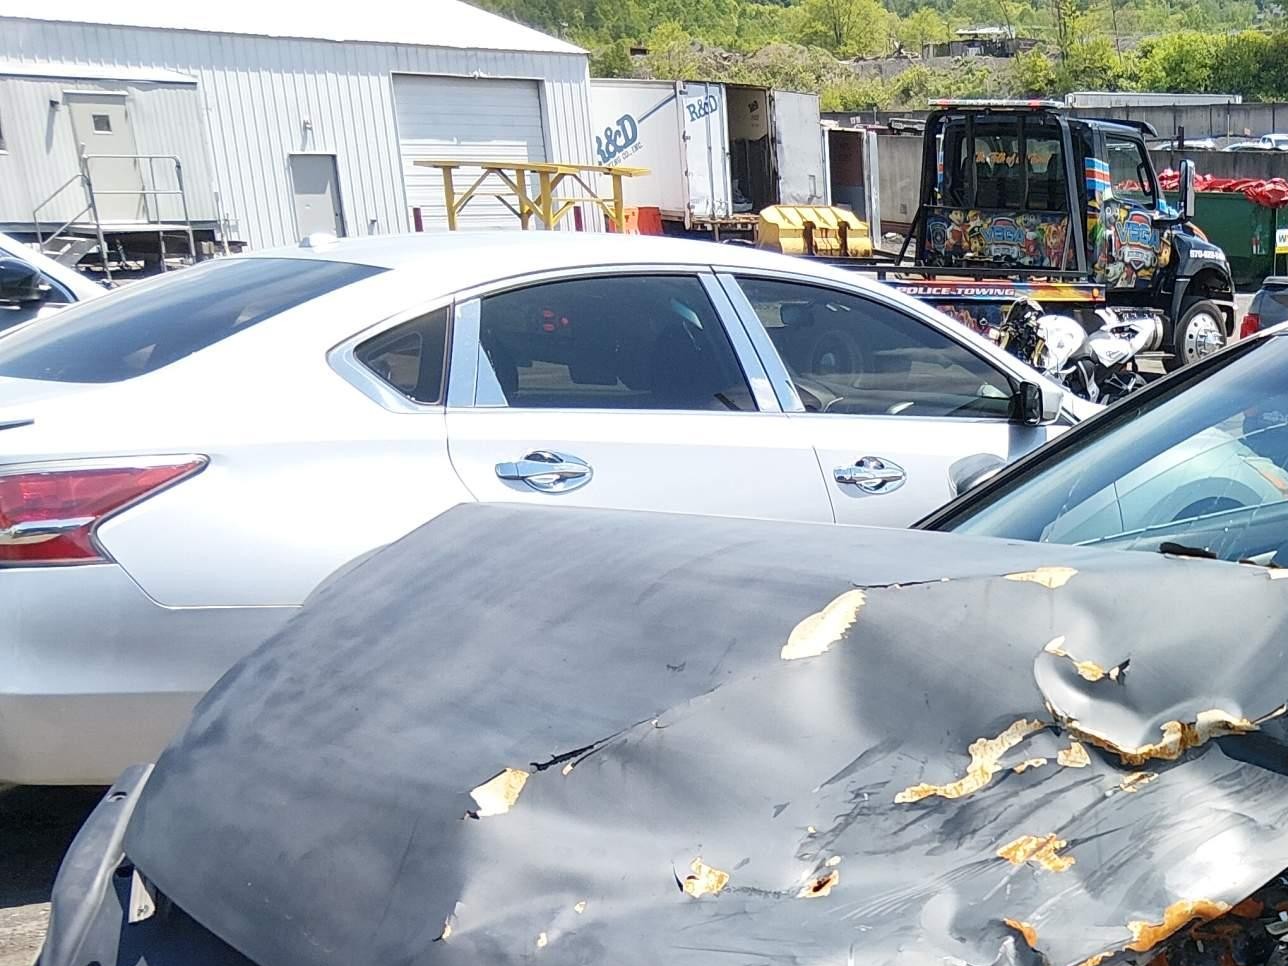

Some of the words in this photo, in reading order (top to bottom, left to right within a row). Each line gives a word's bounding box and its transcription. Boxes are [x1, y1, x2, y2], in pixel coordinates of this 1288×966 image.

[686, 95, 718, 122] R&D
[980, 226, 1025, 245] VEGA
[1115, 222, 1160, 253] VEGA
[955, 286, 1016, 296] TOWING
